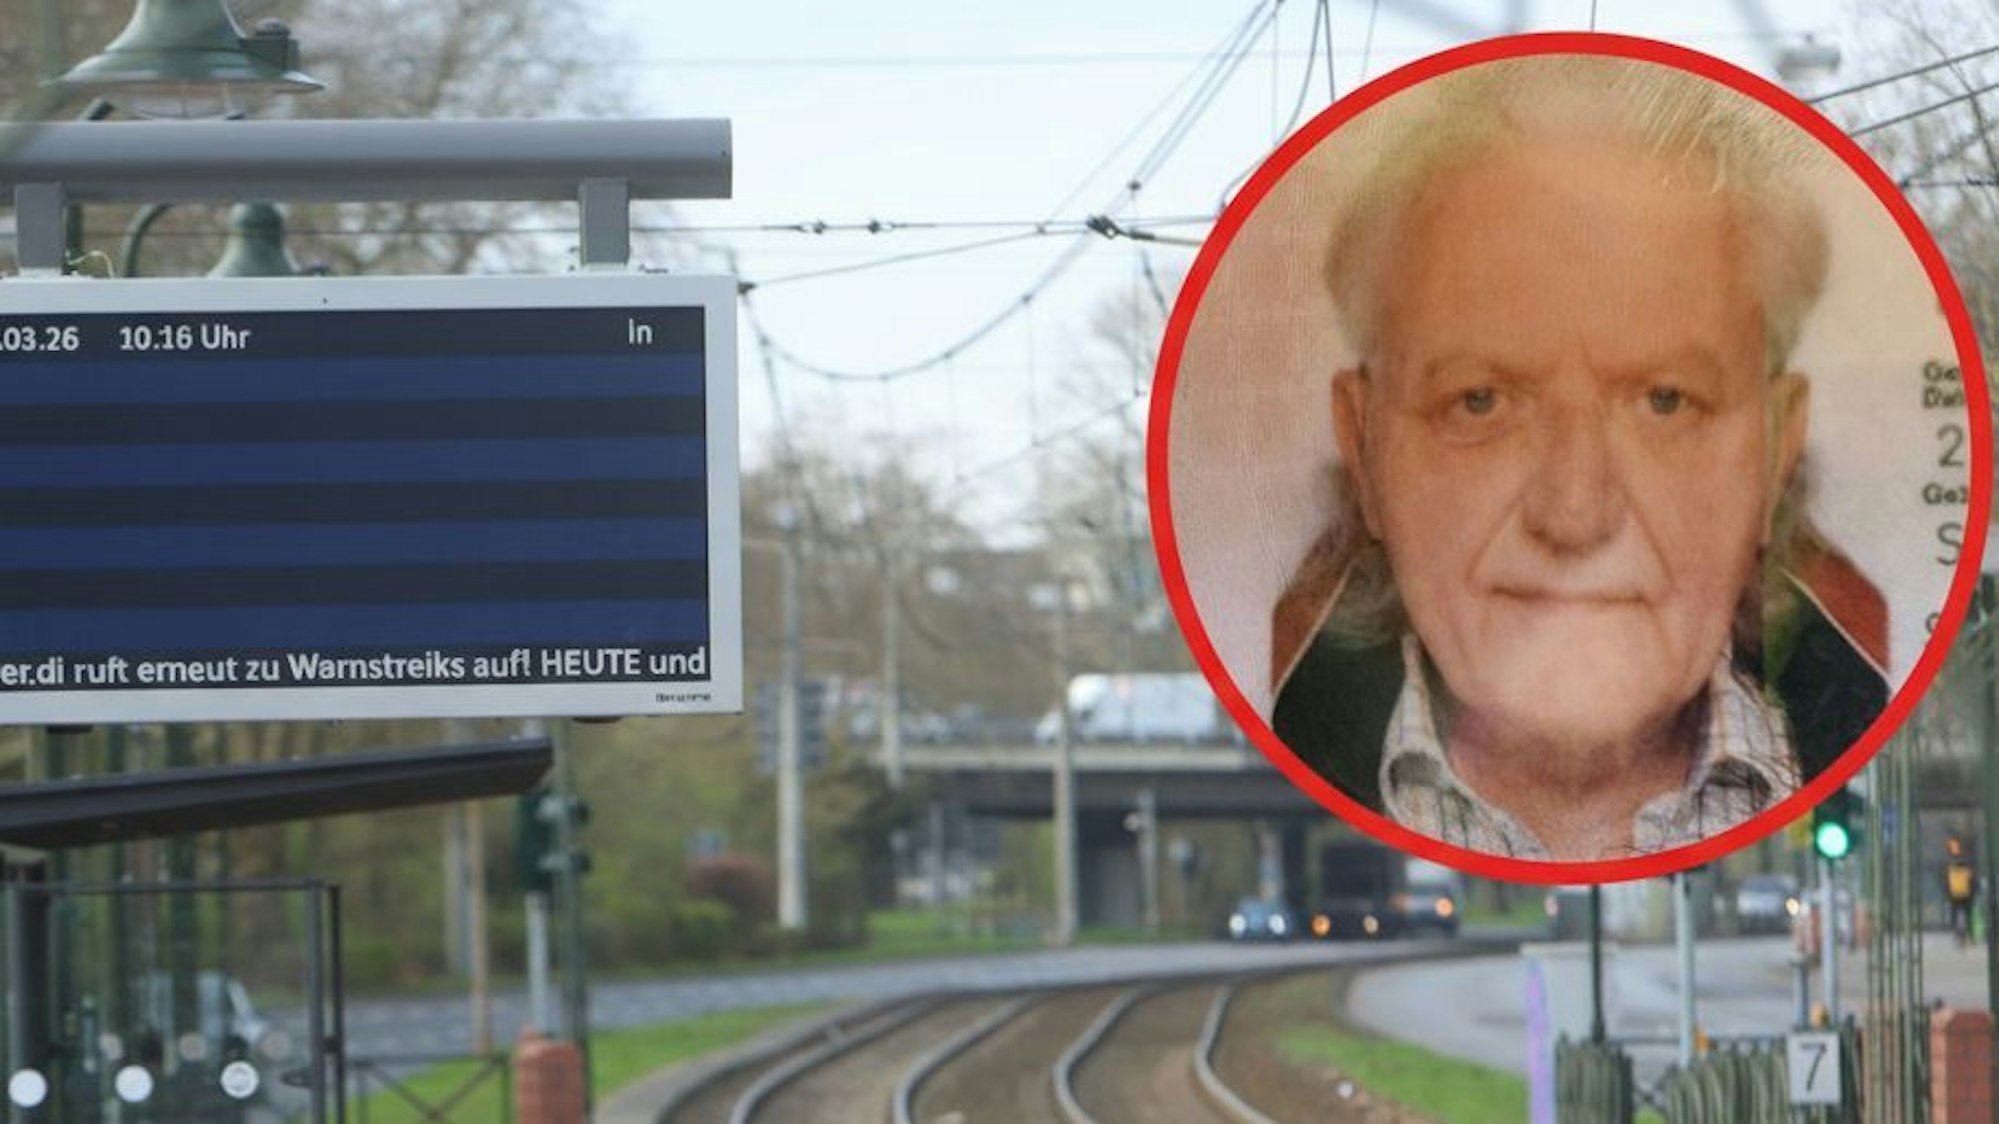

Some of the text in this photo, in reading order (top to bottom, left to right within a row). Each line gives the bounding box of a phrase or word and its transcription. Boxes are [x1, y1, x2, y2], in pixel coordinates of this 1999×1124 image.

[119, 325, 193, 350] 10.16
[200, 324, 250, 349] Uhr
[74, 655, 129, 684] ruft
[136, 657, 239, 683] erneut
[245, 659, 280, 682] zu
[286, 651, 466, 681] Warnstreiks
[541, 648, 641, 677] HEUTE
[650, 646, 706, 675] und
[1799, 1042, 1827, 1091] 7
